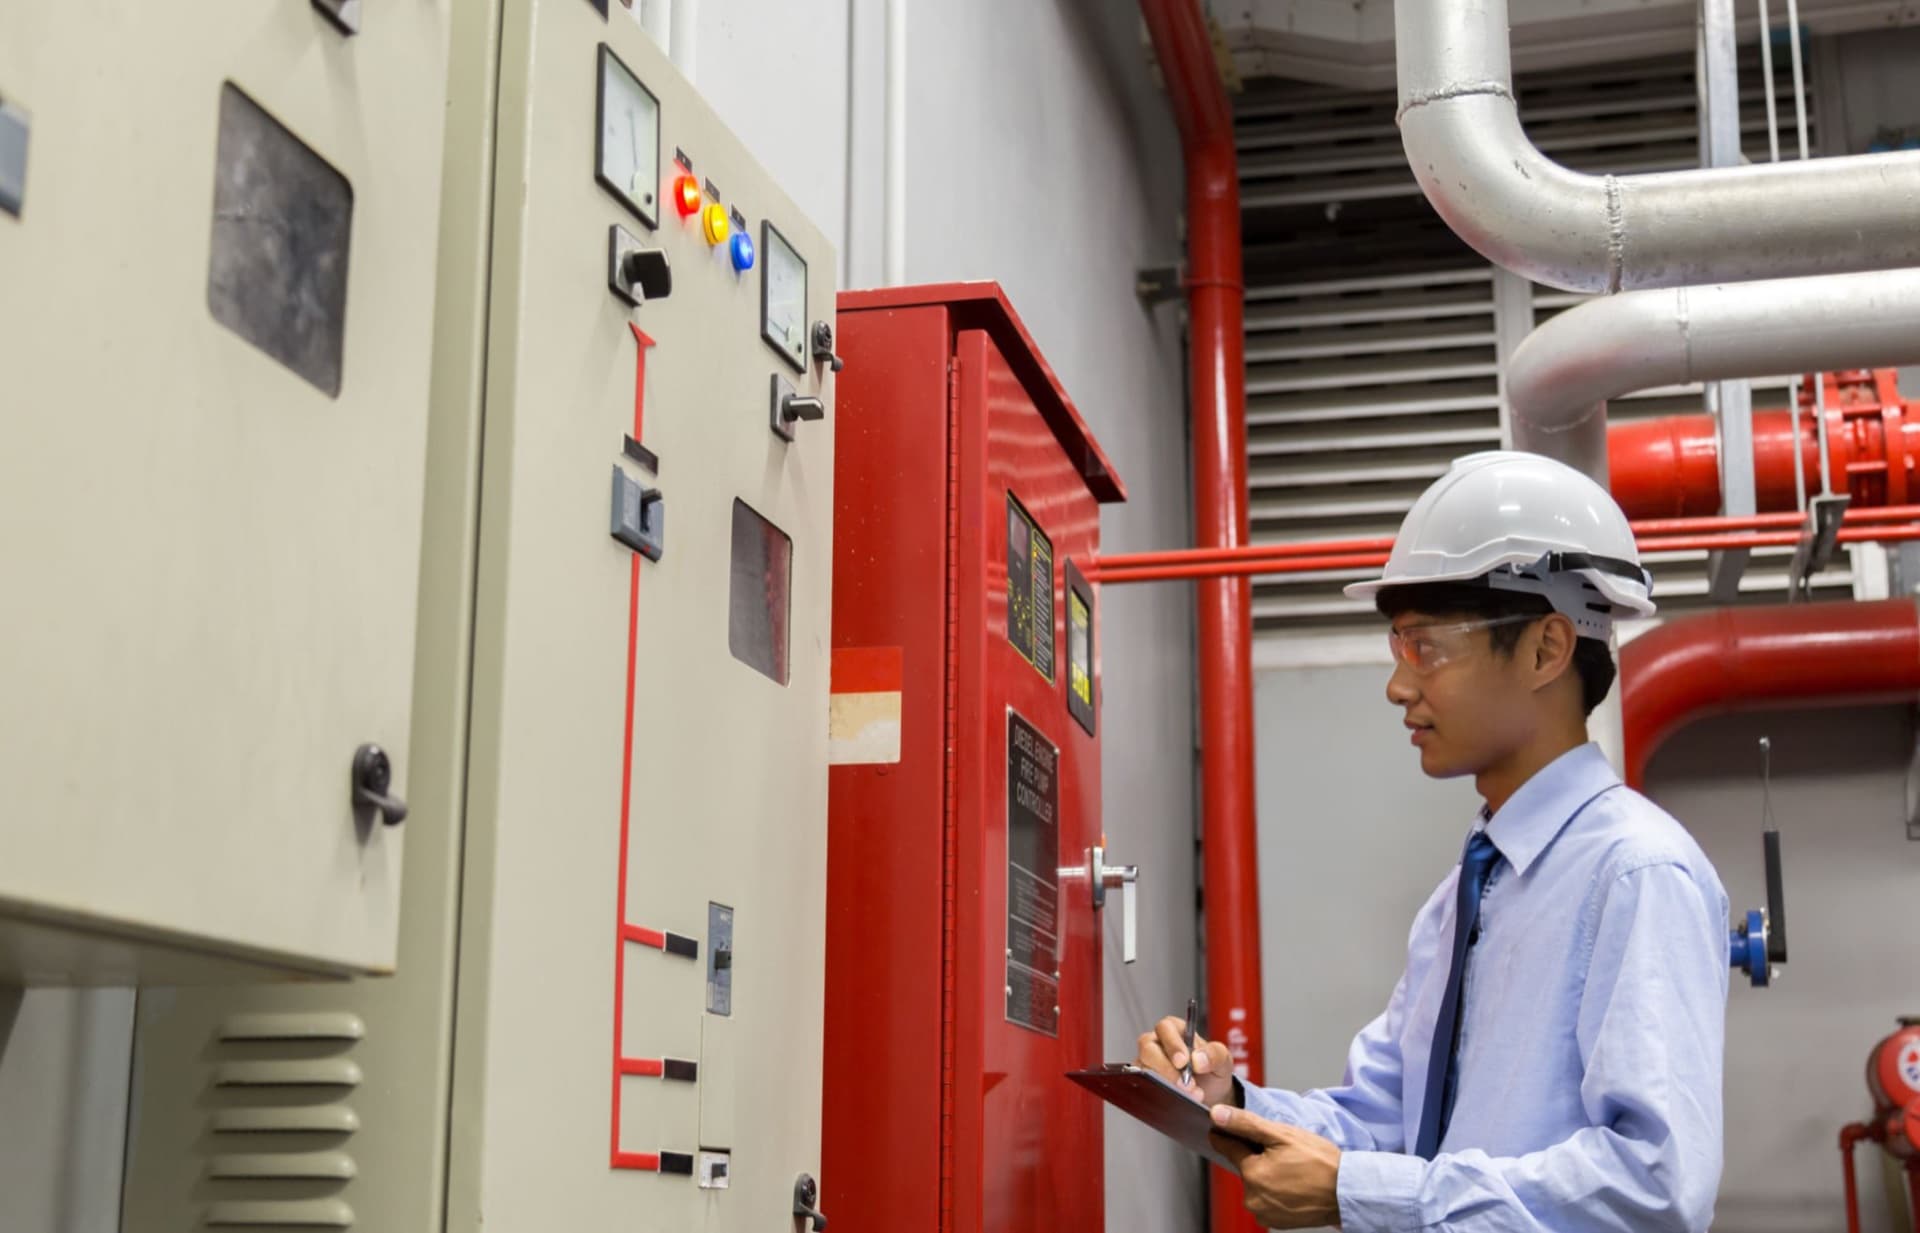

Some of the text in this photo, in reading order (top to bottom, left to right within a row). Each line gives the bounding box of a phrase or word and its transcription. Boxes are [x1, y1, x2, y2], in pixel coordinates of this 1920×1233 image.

[1015, 724, 1034, 759] DIESEL
[1021, 757, 1034, 784] FIRE
[1016, 781, 1053, 824] CONTROLLER
